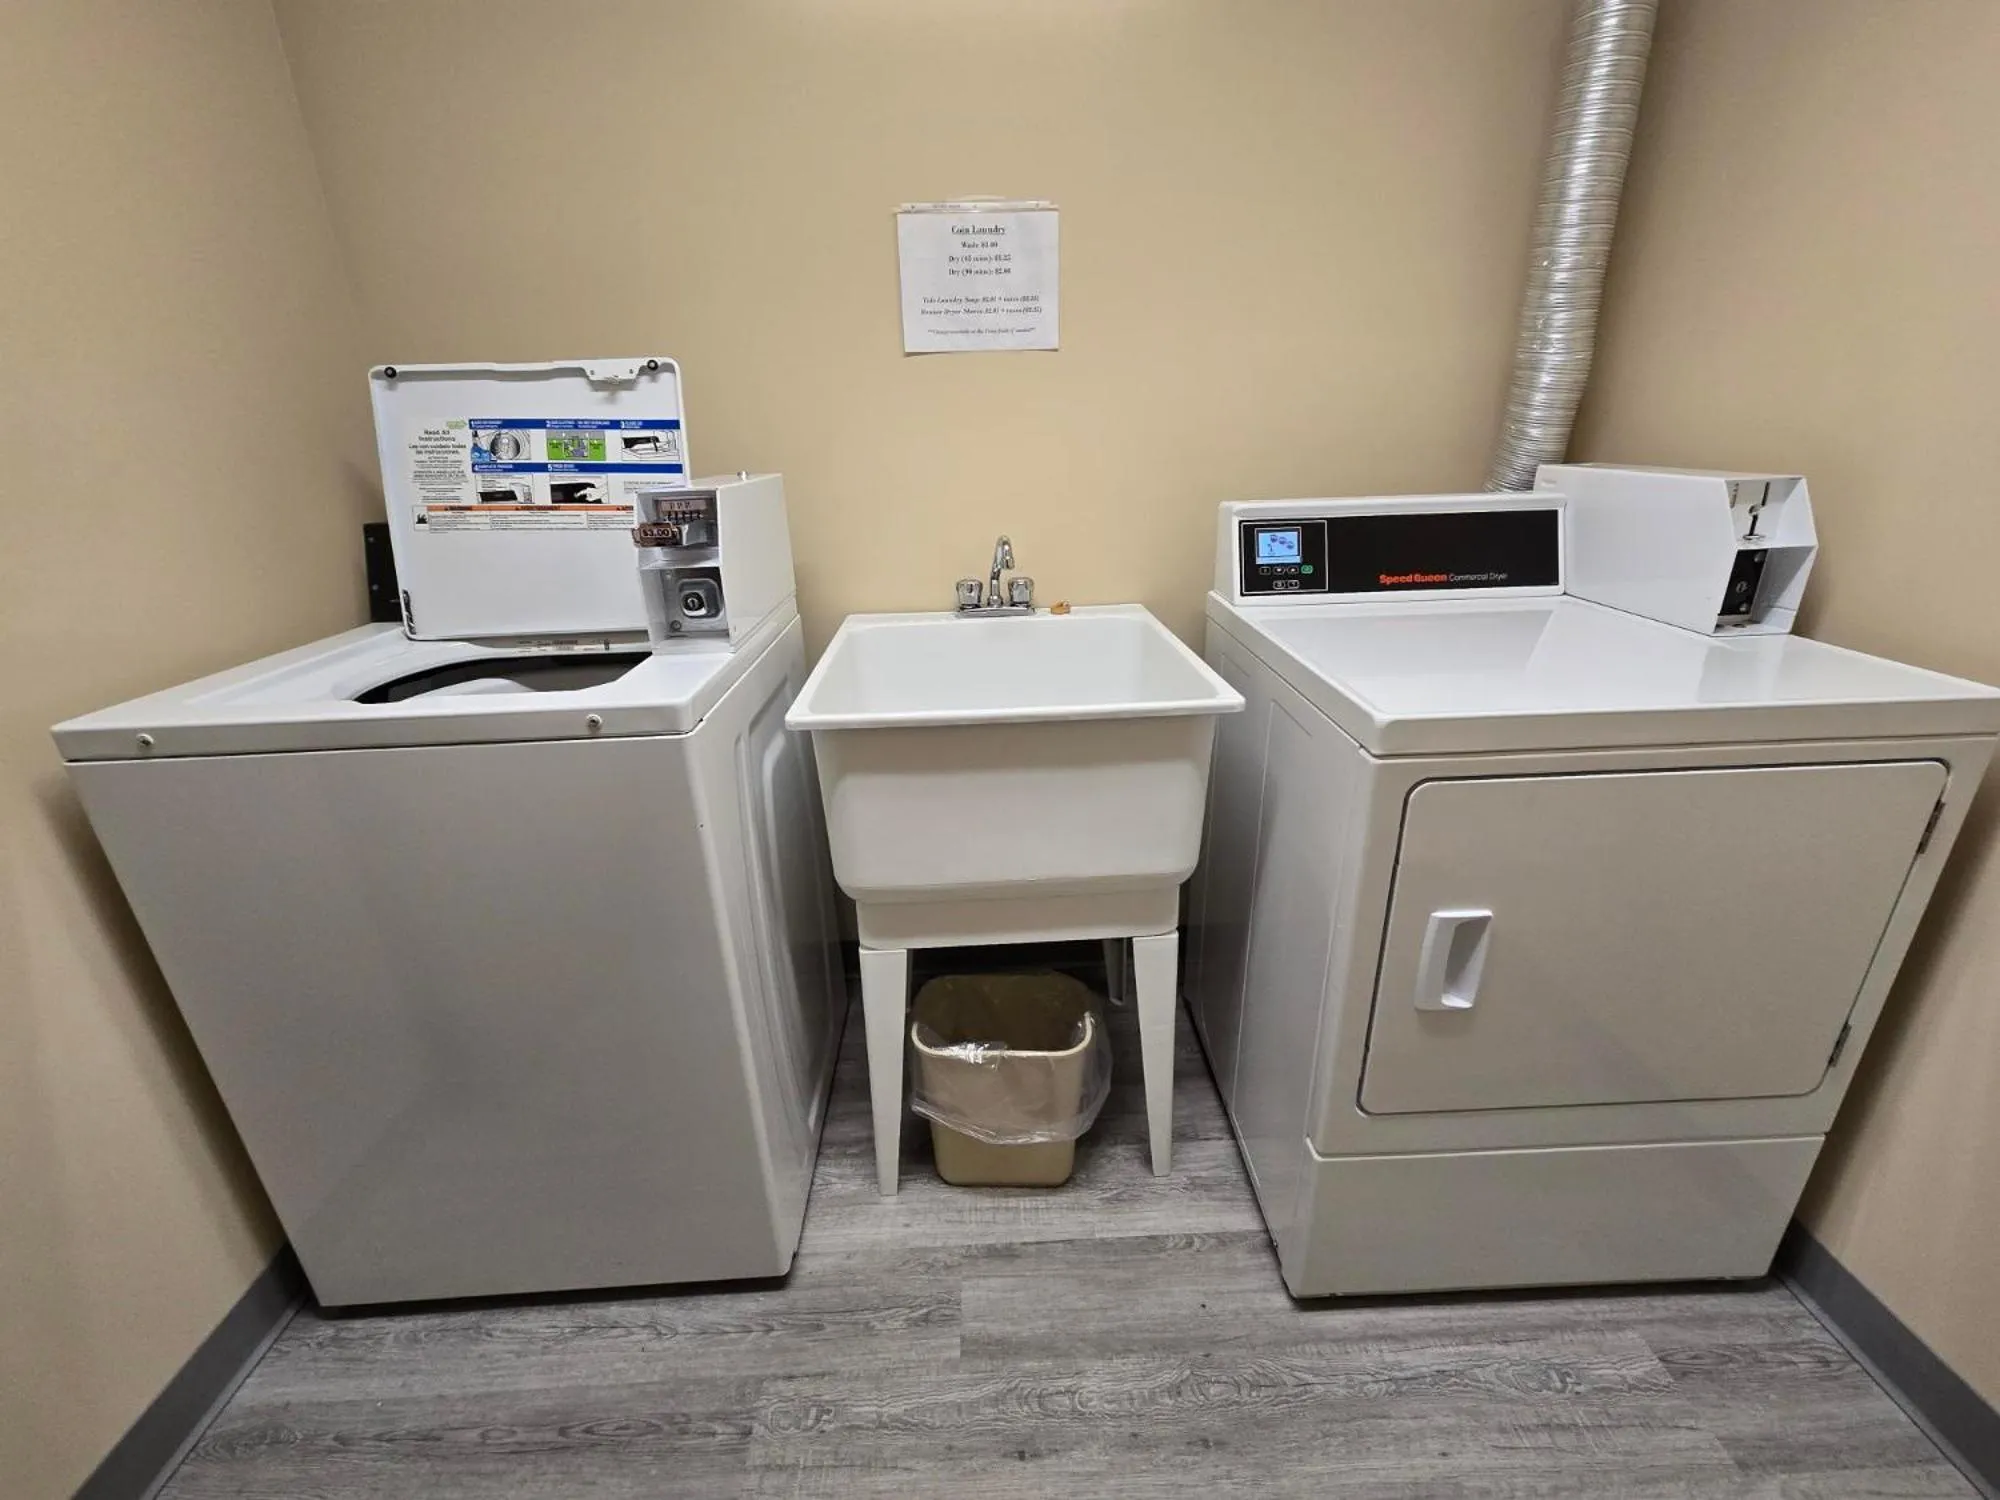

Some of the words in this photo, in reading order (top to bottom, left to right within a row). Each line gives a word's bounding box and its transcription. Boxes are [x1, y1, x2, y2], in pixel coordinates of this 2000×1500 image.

[971, 224, 1006, 236] Laundry
[948, 255, 960, 264] Dry
[948, 268, 960, 276] Dry
[642, 528, 670, 537] $3.00
[1379, 574, 1412, 585] Speed
[1414, 573, 1447, 583] Queen
[1448, 573, 1488, 581] Commercial
[1489, 572, 1508, 582] Dryer
